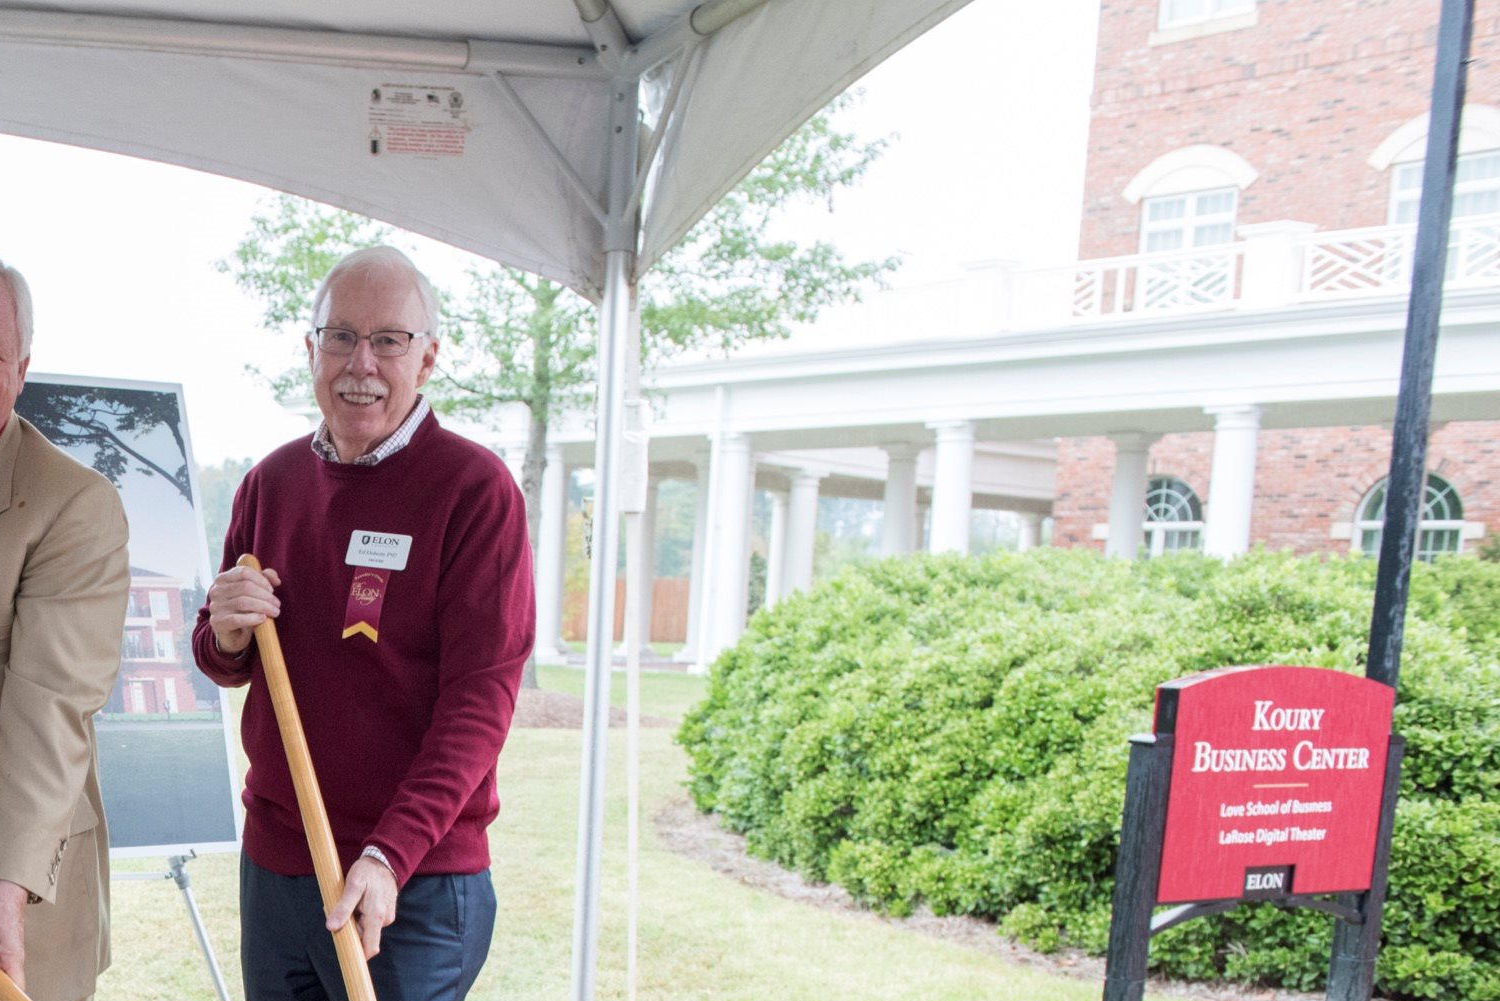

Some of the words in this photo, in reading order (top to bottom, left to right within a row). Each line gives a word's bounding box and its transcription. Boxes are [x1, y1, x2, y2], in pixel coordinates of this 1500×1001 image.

[372, 536, 399, 545] ELON
[351, 588, 380, 597] ELON
[1220, 803, 1245, 818] Love
[1246, 801, 1280, 817] School
[1280, 800, 1292, 815] of
[1292, 799, 1332, 814] Business
[1219, 830, 1254, 845] LaRose
[1255, 828, 1289, 846] Digital
[1290, 827, 1327, 842] Theater
[1245, 873, 1284, 890] ELON
